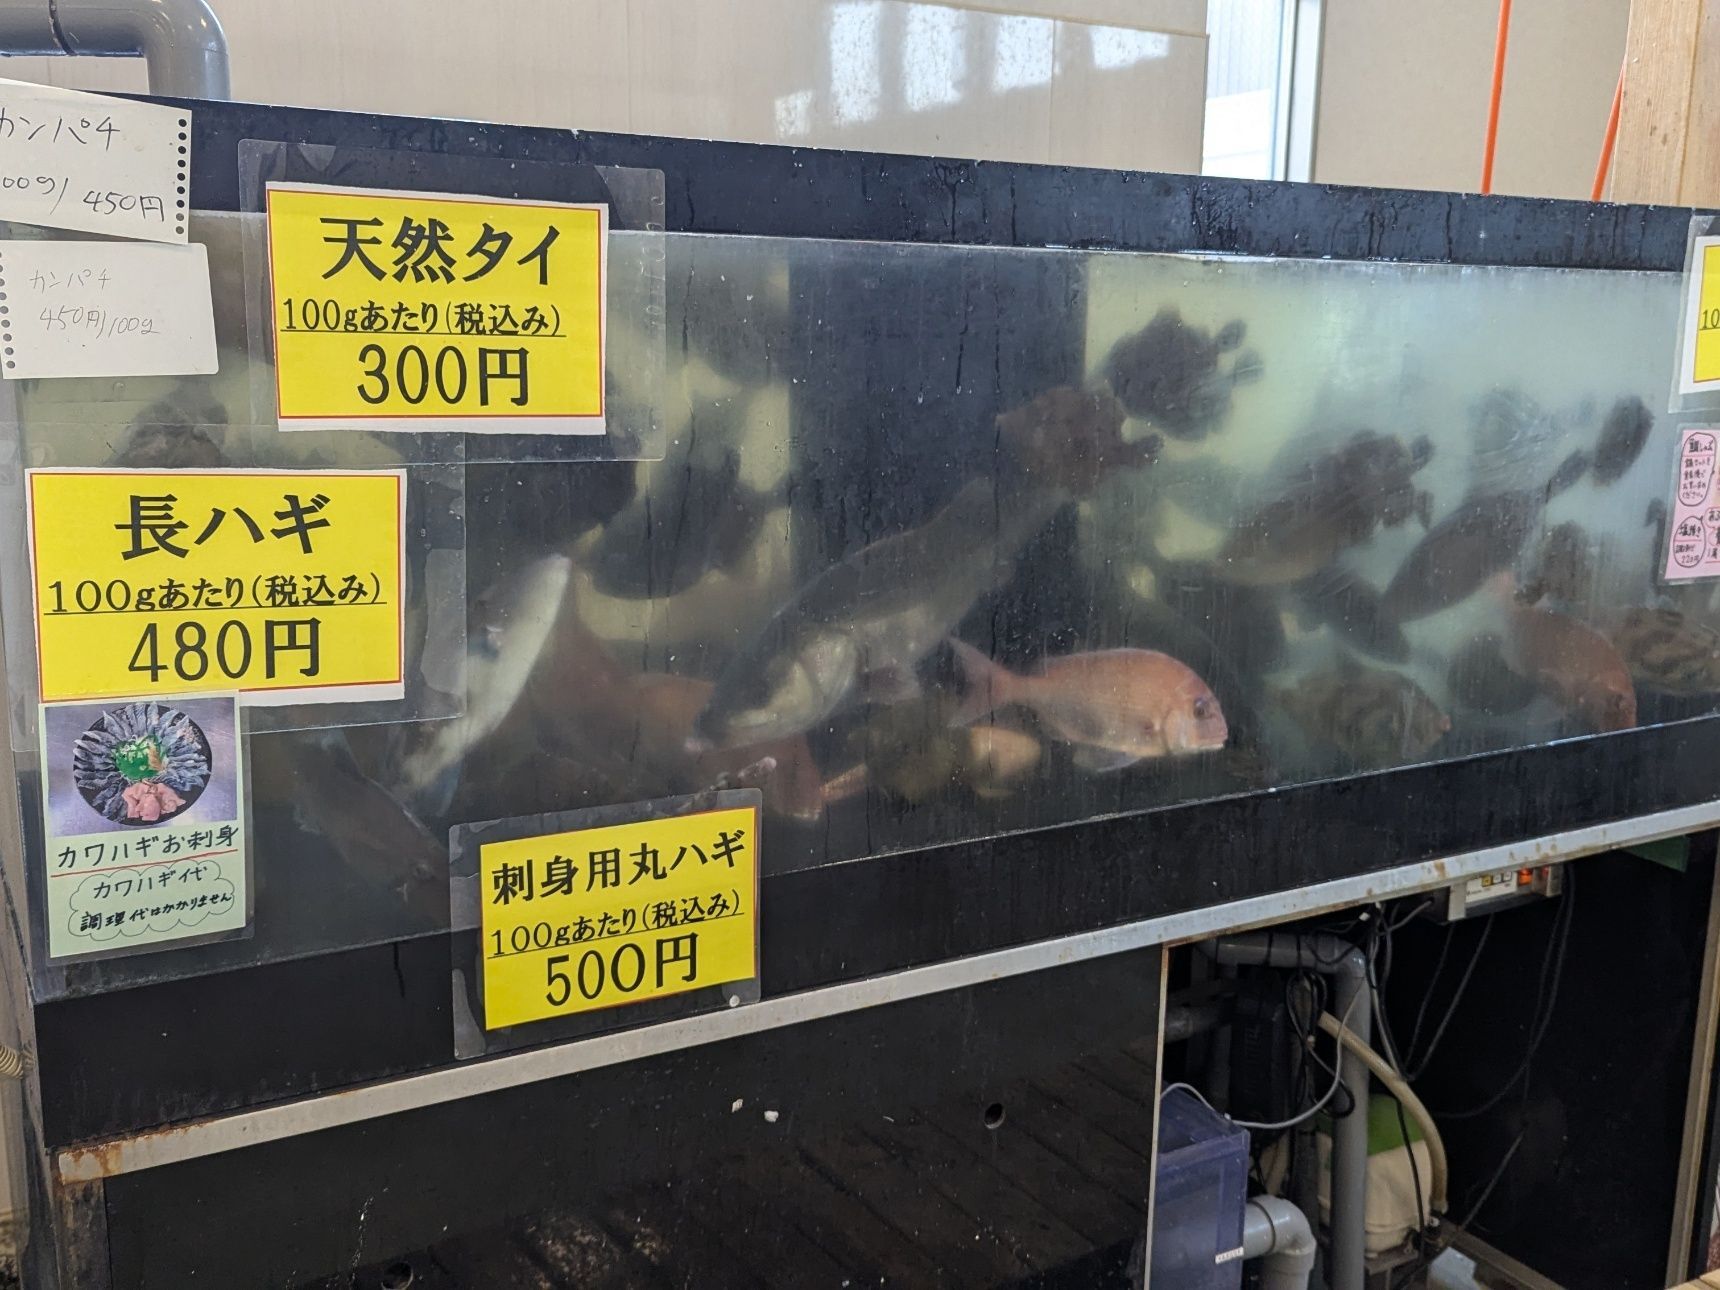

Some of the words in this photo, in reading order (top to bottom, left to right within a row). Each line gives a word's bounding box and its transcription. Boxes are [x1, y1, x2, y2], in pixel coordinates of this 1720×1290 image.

[1, 175, 69, 216] 00g/
[82, 189, 165, 223] 450円
[319, 215, 561, 286] 天然タイ
[29, 268, 112, 290] カンパチ
[282, 297, 561, 336] 100gあたり(税込み)
[356, 343, 530, 407] 300円
[113, 492, 332, 561] 長ハギ
[48, 571, 381, 613] 100gあたり(税込み)
[127, 616, 322, 683] 480円
[57, 824, 239, 869] カワハギお刺身
[491, 829, 746, 906] 刺身用丸ハギ
[92, 865, 208, 900] カワハギ代
[79, 892, 233, 932] 調理代はかかりません
[490, 888, 741, 957] 100gあたり(税込み)
[545, 931, 699, 1007] 500円
